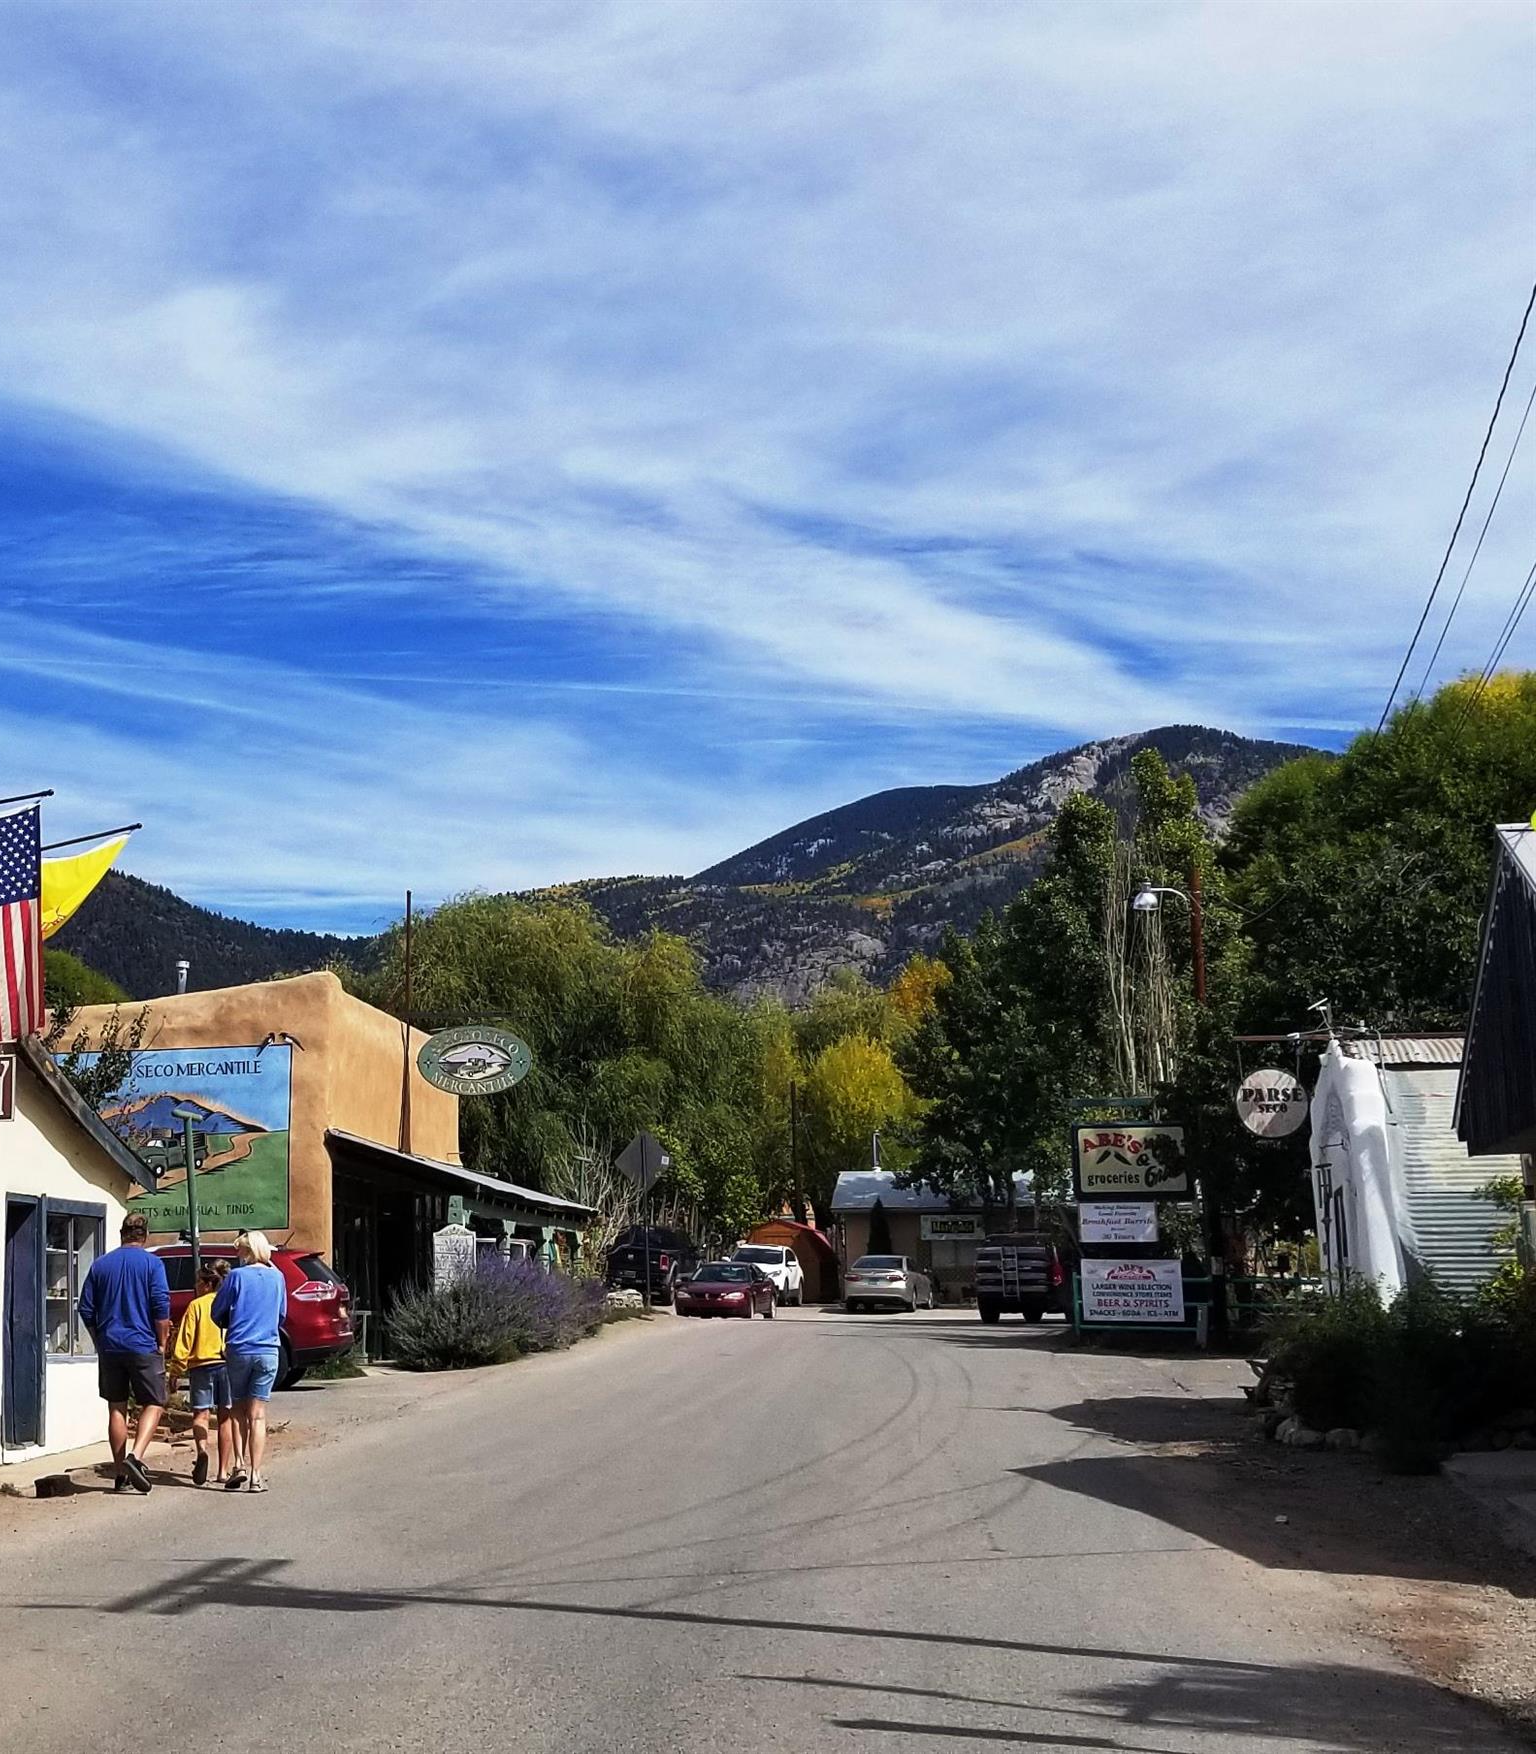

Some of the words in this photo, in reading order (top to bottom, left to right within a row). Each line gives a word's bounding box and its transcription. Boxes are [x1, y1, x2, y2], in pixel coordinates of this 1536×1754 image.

[136, 1064, 174, 1078] SECO
[176, 1060, 262, 1077] MERCANTILE
[431, 1072, 518, 1094] MERCANTILE
[1242, 1087, 1304, 1103] PARSE
[1257, 1103, 1288, 1114] SECO
[1083, 1132, 1143, 1154] ABE'S
[1087, 1170, 1140, 1187] groceries
[175, 1205, 220, 1217] UNSUAL
[1096, 1299, 1121, 1308] BEER
[1122, 1299, 1132, 1308] &
[1133, 1299, 1170, 1308] SPIRITS
